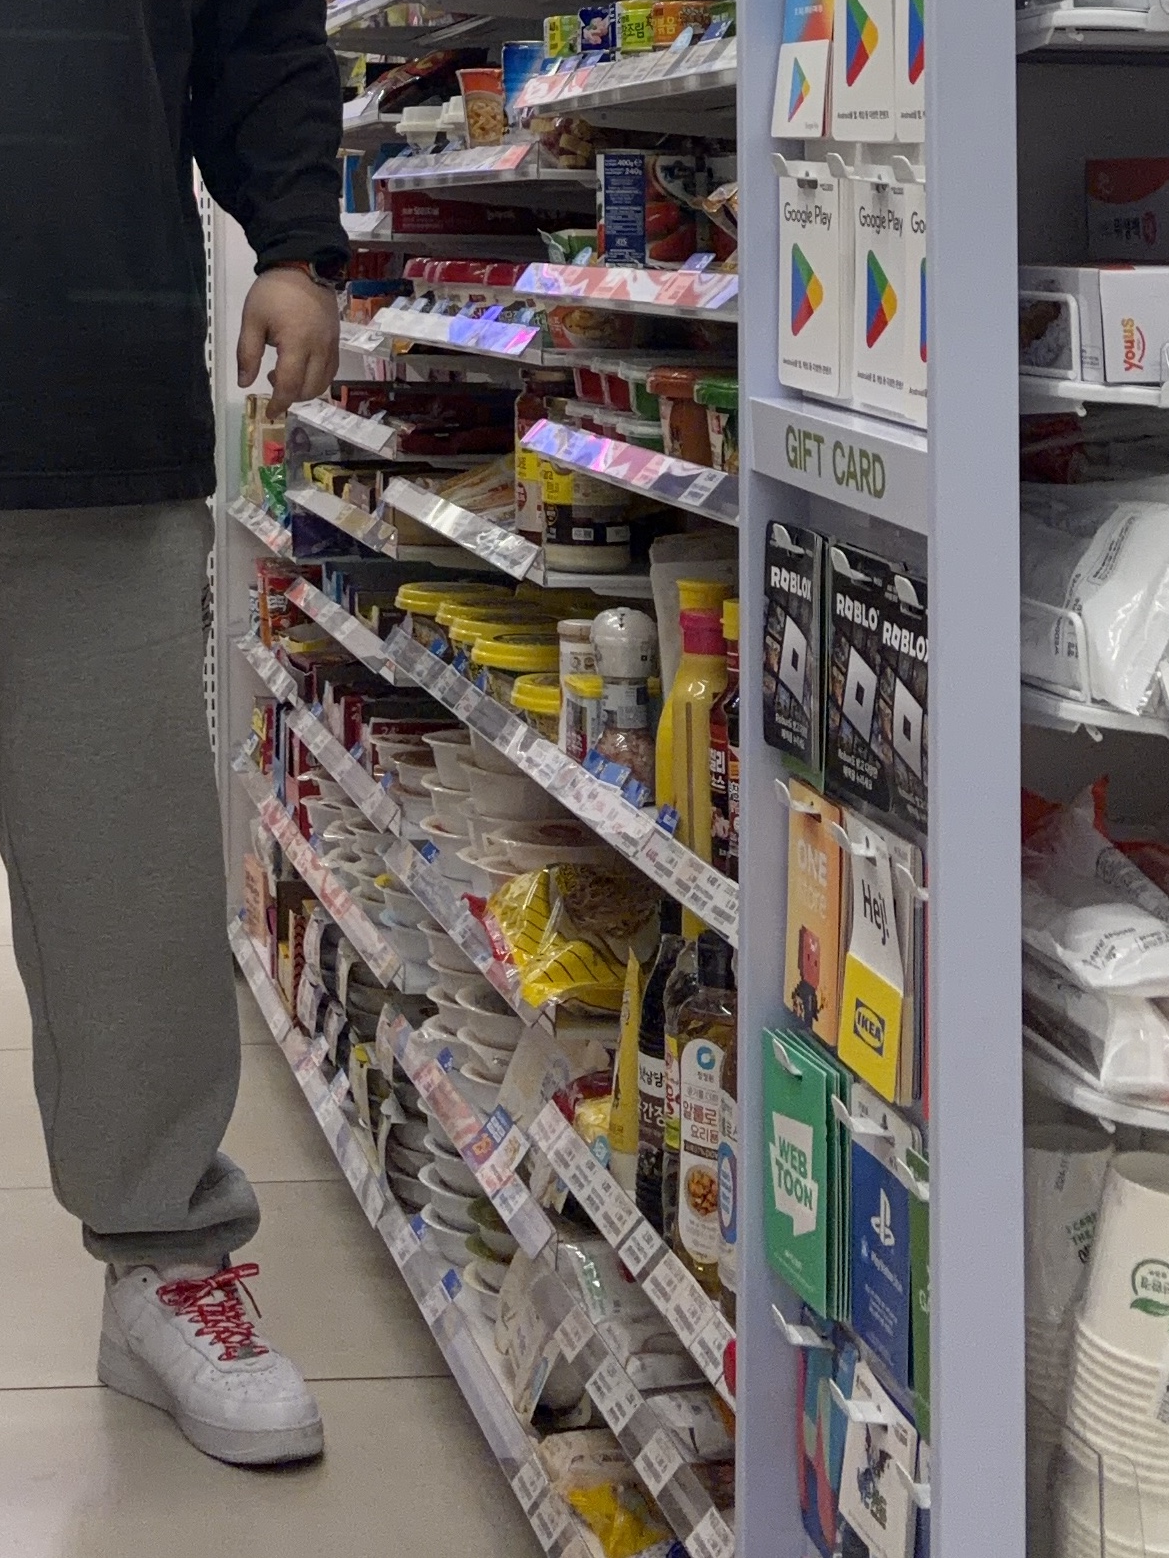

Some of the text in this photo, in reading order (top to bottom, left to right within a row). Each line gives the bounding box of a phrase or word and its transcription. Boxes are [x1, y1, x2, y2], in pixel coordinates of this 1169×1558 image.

[783, 201, 833, 232] Google Play
[858, 205, 904, 238] Google Play
[784, 423, 887, 500] GIFT CARD
[770, 565, 812, 603] ROBLOX
[835, 592, 881, 632] ROBLO
[860, 878, 890, 946] Hej!
[856, 1010, 883, 1044] IKEA
[778, 1137, 809, 1180] WEB
[774, 1157, 815, 1211] TOON
